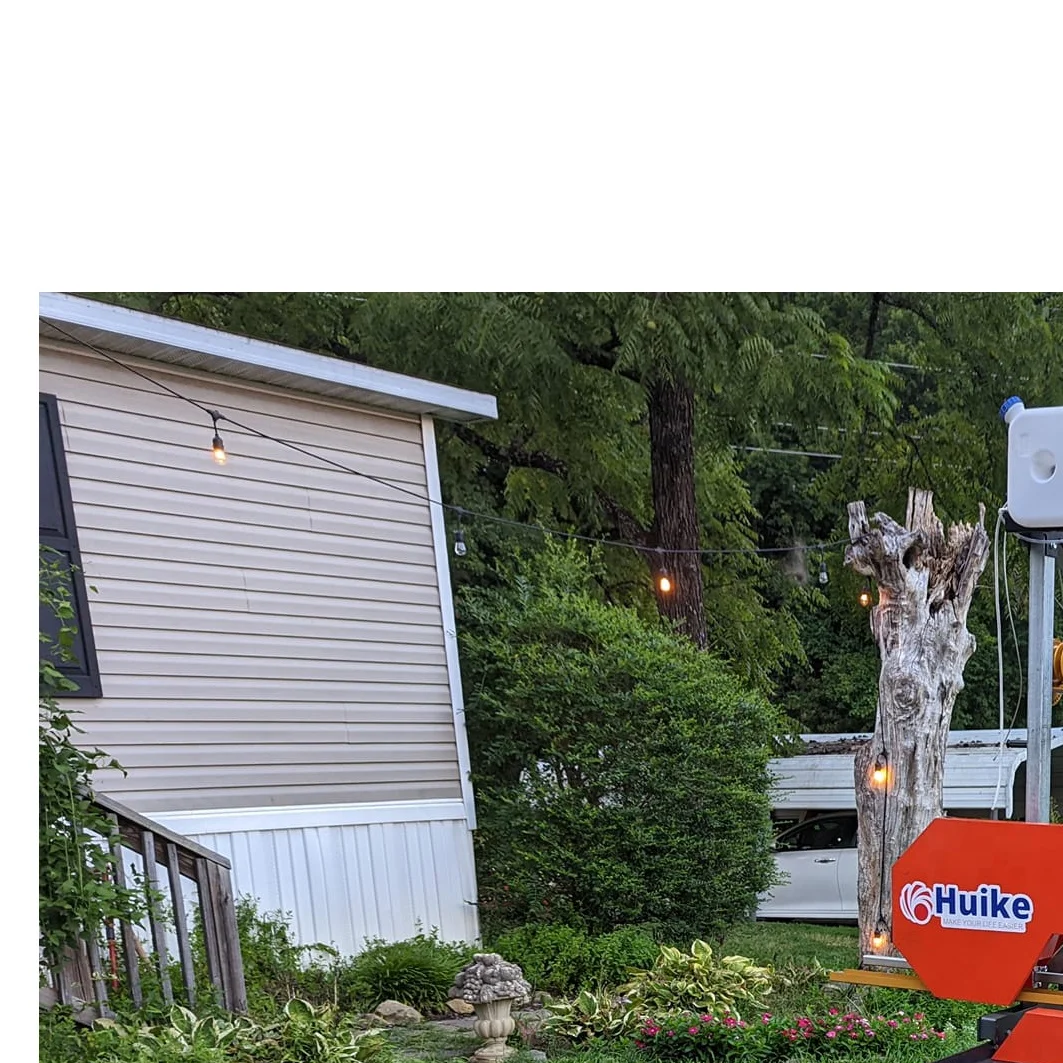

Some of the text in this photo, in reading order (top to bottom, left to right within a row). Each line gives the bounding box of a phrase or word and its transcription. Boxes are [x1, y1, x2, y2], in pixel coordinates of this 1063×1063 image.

[935, 886, 1031, 920] Huike
[943, 918, 960, 926] MAKE
[962, 919, 981, 928] YOUR
[998, 921, 1024, 931] EASIER
